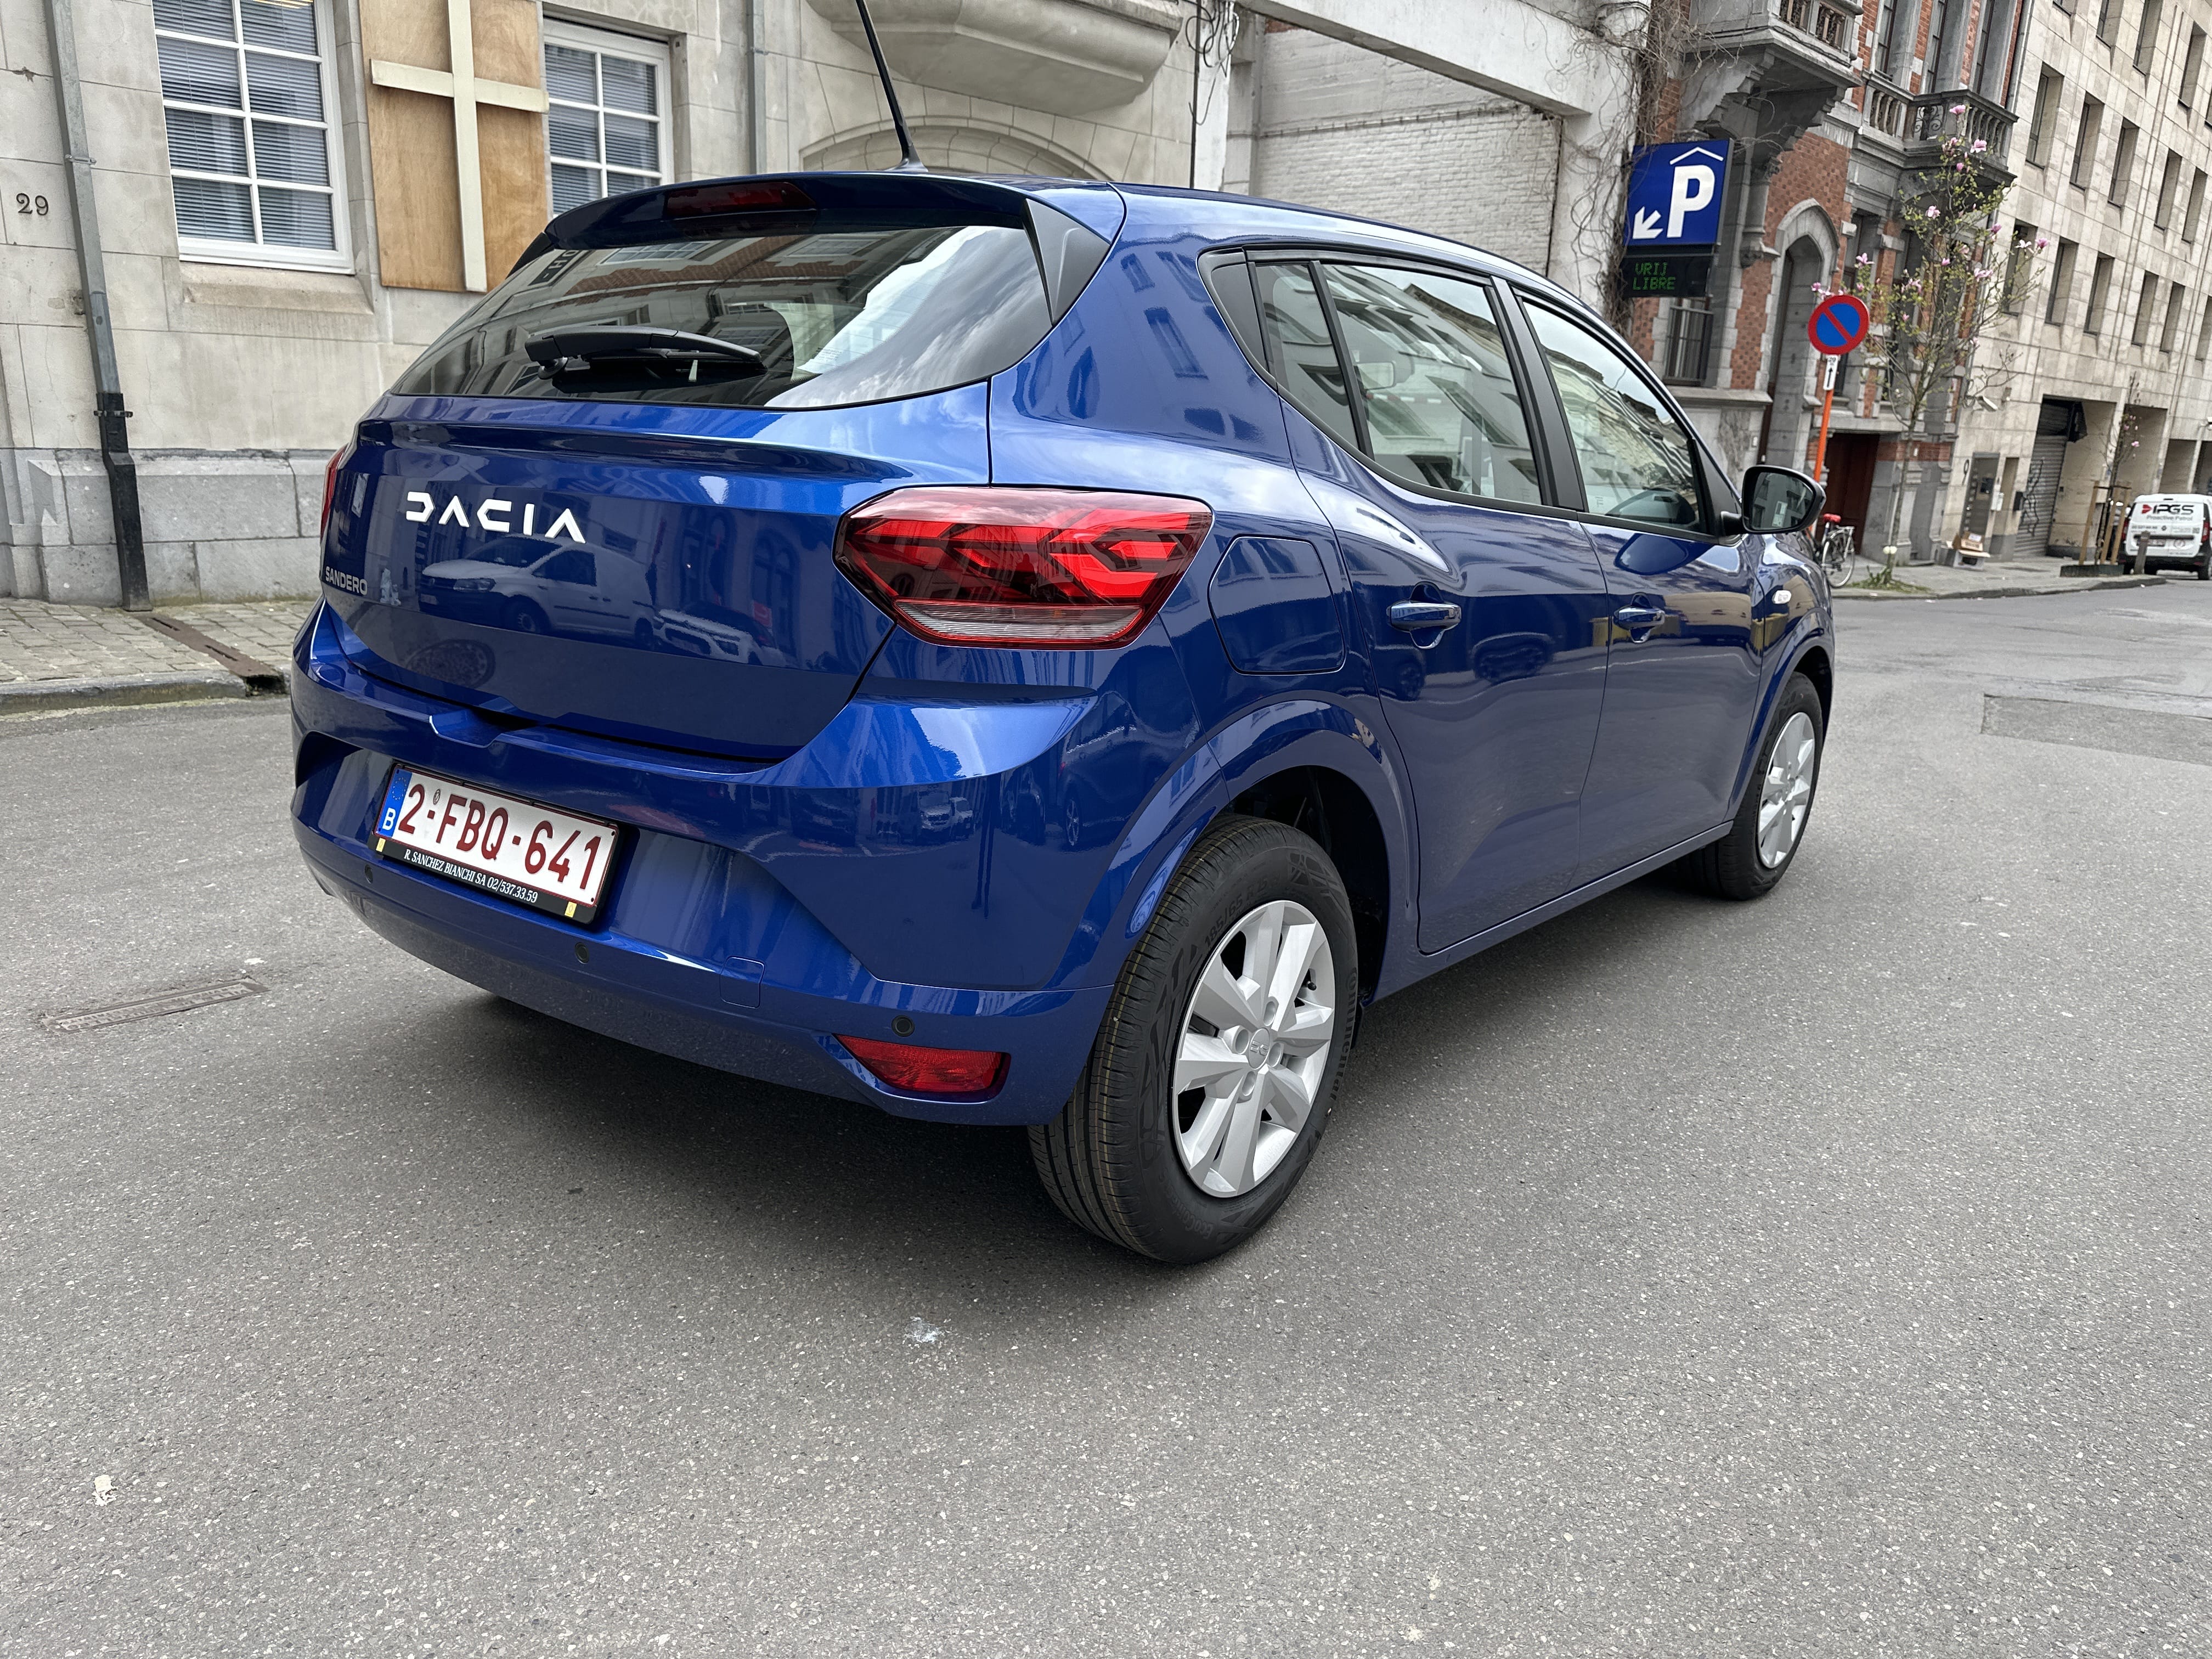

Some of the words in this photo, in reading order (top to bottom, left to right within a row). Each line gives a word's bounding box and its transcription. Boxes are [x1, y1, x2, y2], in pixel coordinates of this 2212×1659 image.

[16, 193, 49, 216] 29
[1667, 165, 1715, 238] P
[1635, 262, 1668, 275] VRIJ
[1633, 276, 1676, 290] LIBRE
[406, 492, 586, 544] DACIA
[325, 566, 368, 595] SANDERO
[382, 809, 396, 831] B
[411, 852, 445, 872] SANCHEZ
[443, 863, 475, 883] BIANCHI
[475, 872, 486, 886] SA
[487, 877, 538, 903] 02/537.33.59
